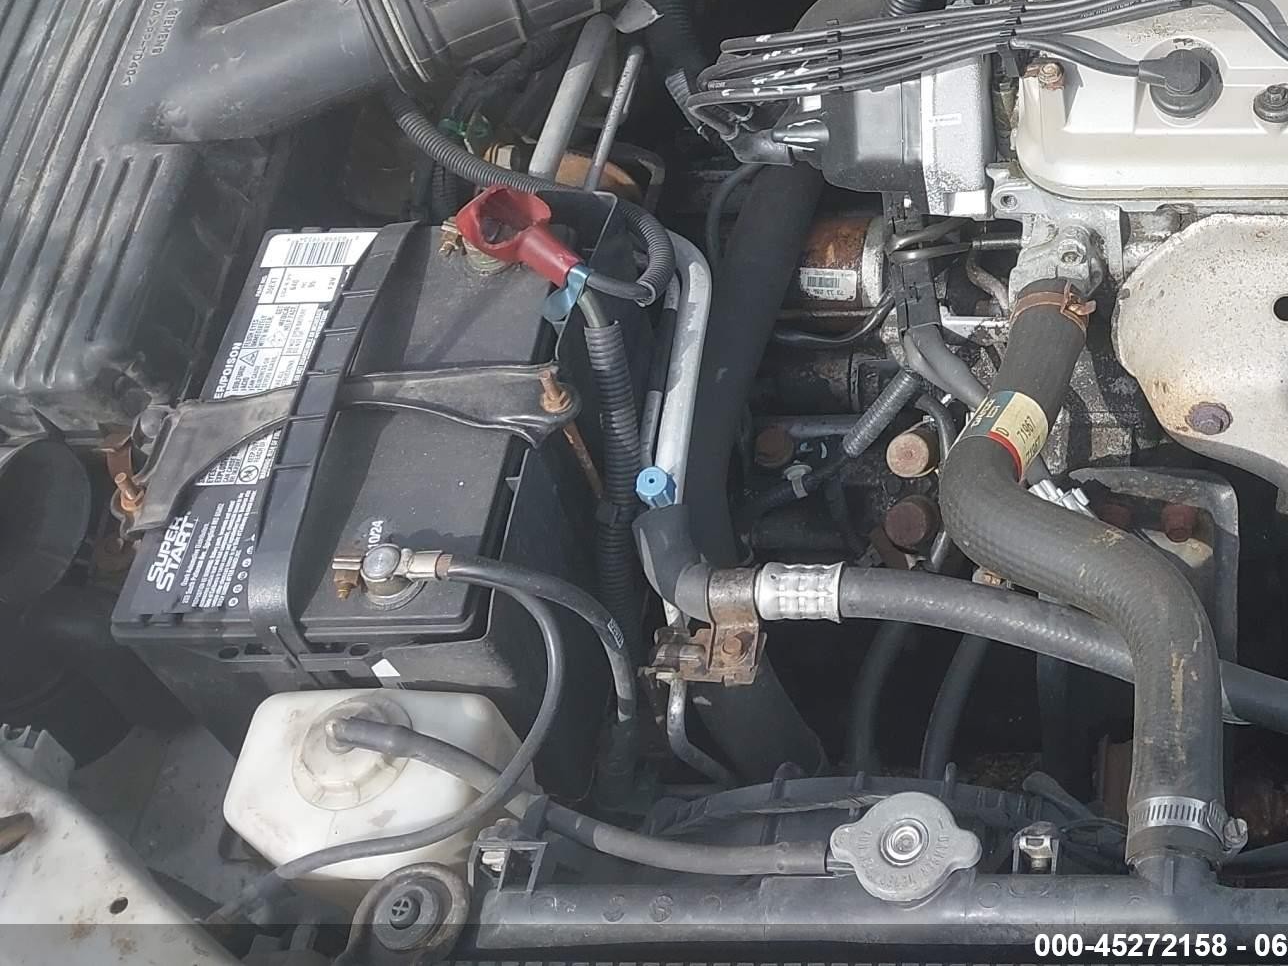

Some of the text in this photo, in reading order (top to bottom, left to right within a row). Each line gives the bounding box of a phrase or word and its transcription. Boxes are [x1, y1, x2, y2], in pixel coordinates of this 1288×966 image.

[1016, 415, 1036, 444] 71967
[147, 516, 183, 582] SUPER
[156, 515, 195, 592] START
[367, 520, 385, 550] 10/24
